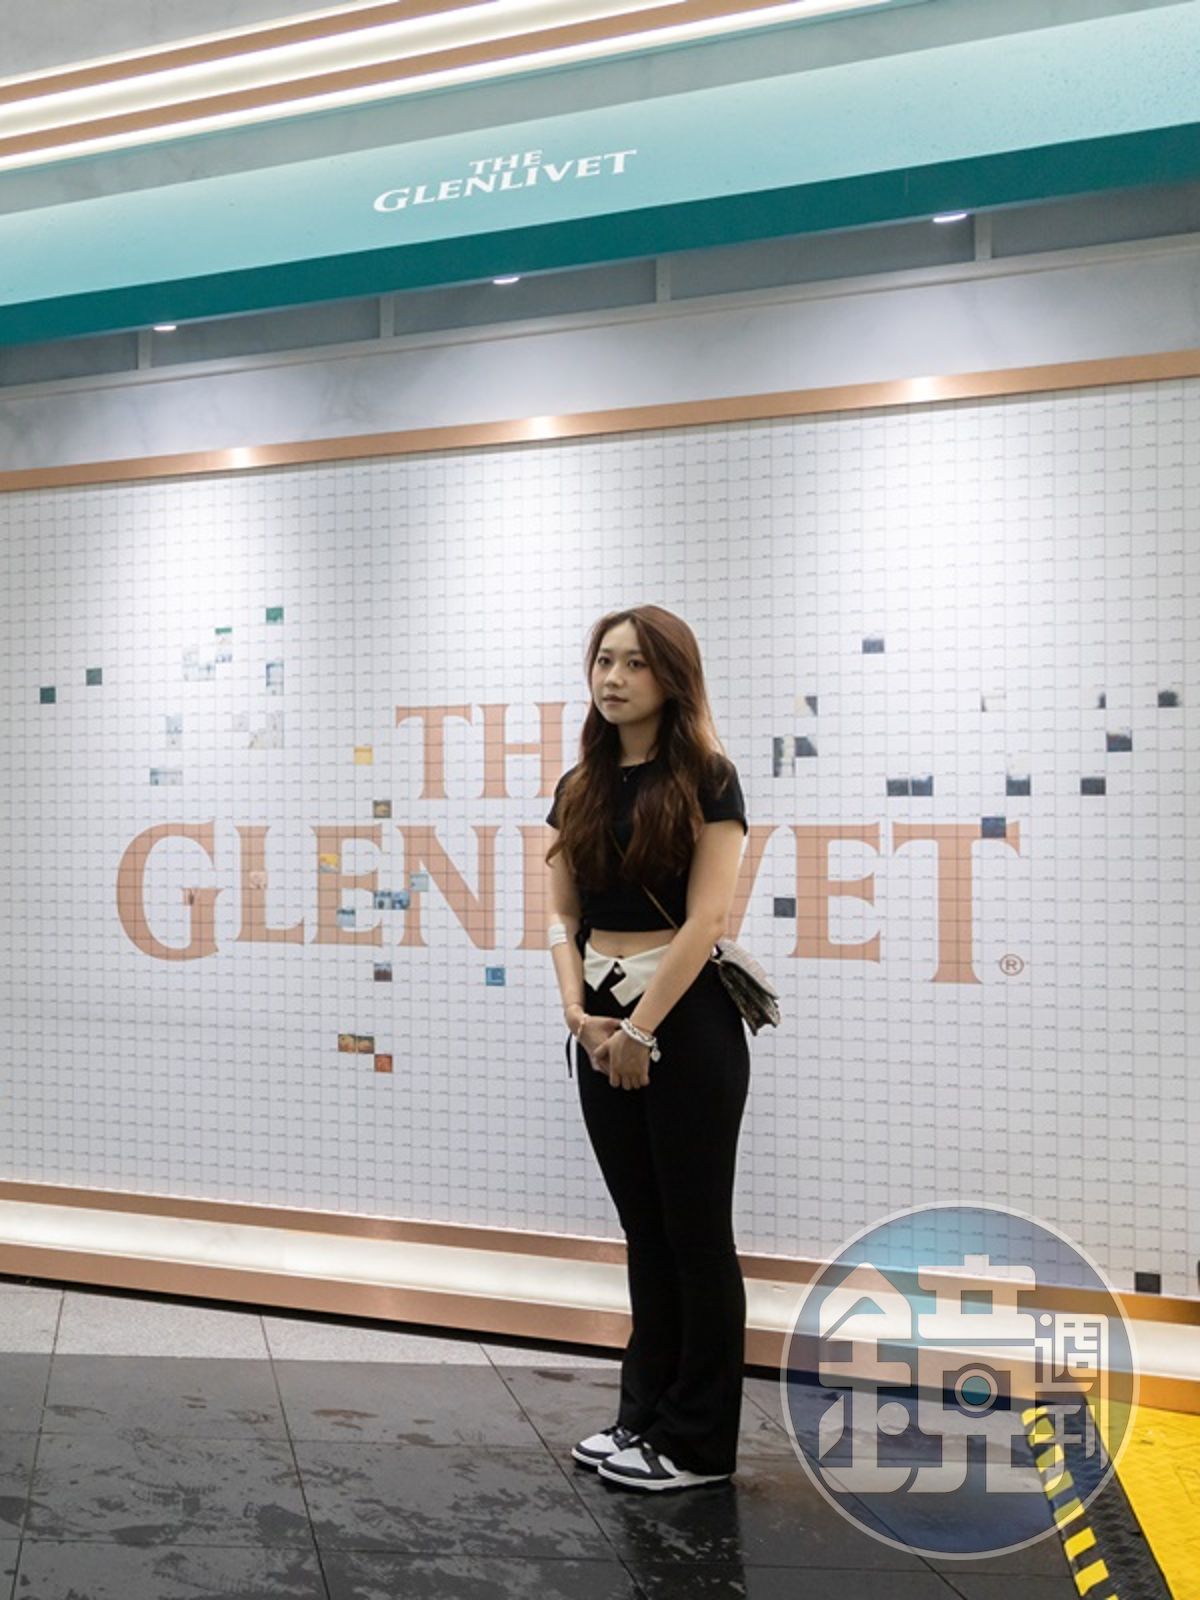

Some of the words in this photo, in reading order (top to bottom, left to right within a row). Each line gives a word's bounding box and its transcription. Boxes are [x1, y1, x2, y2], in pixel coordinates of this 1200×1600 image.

[373, 150, 637, 212] GLENLIVET
[469, 150, 542, 174] THE
[395, 701, 590, 799] TH
[116, 819, 1019, 983] GLENET
